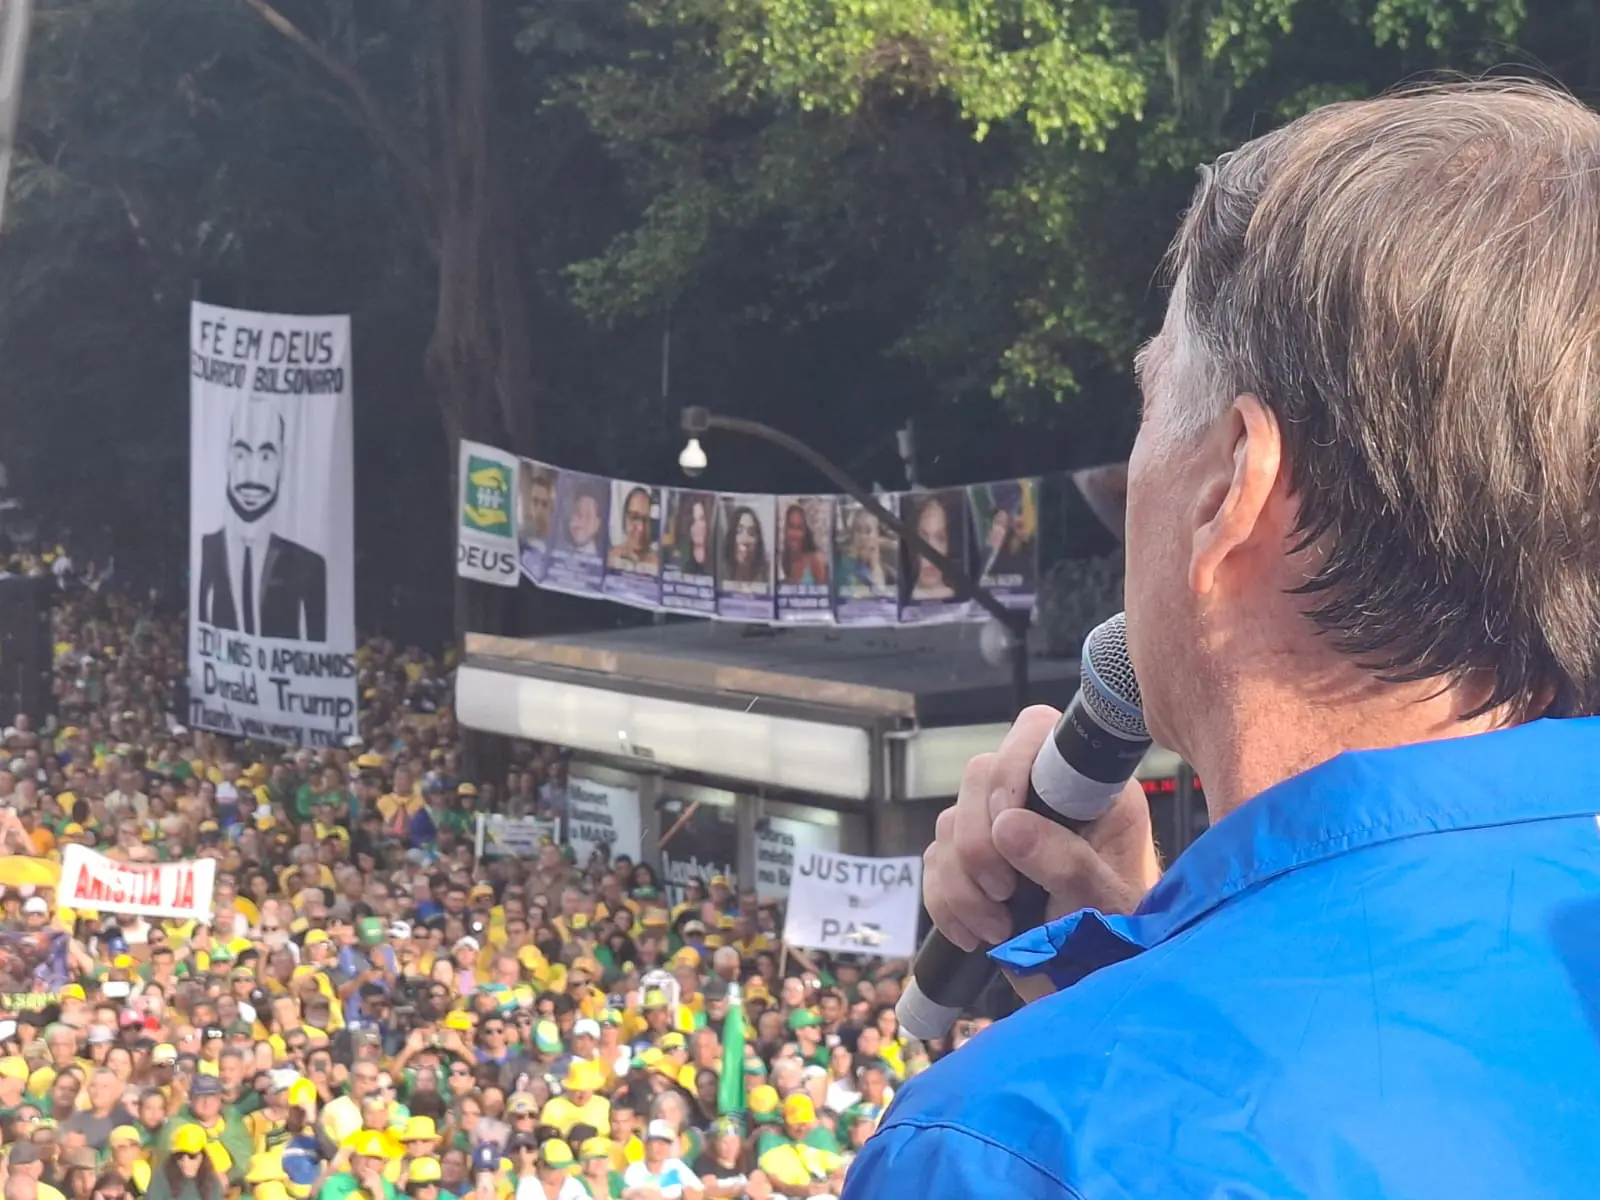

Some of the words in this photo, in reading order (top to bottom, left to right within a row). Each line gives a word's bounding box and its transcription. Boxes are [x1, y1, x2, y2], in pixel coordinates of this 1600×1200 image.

[201, 316, 227, 355] FÉ
[233, 327, 263, 361] EM
[269, 330, 333, 364] DEUS
[253, 366, 344, 395] BOLSONARO
[268, 677, 354, 730] Trump
[800, 854, 914, 892] JUSTIÇA
[820, 918, 882, 947] PAZ
